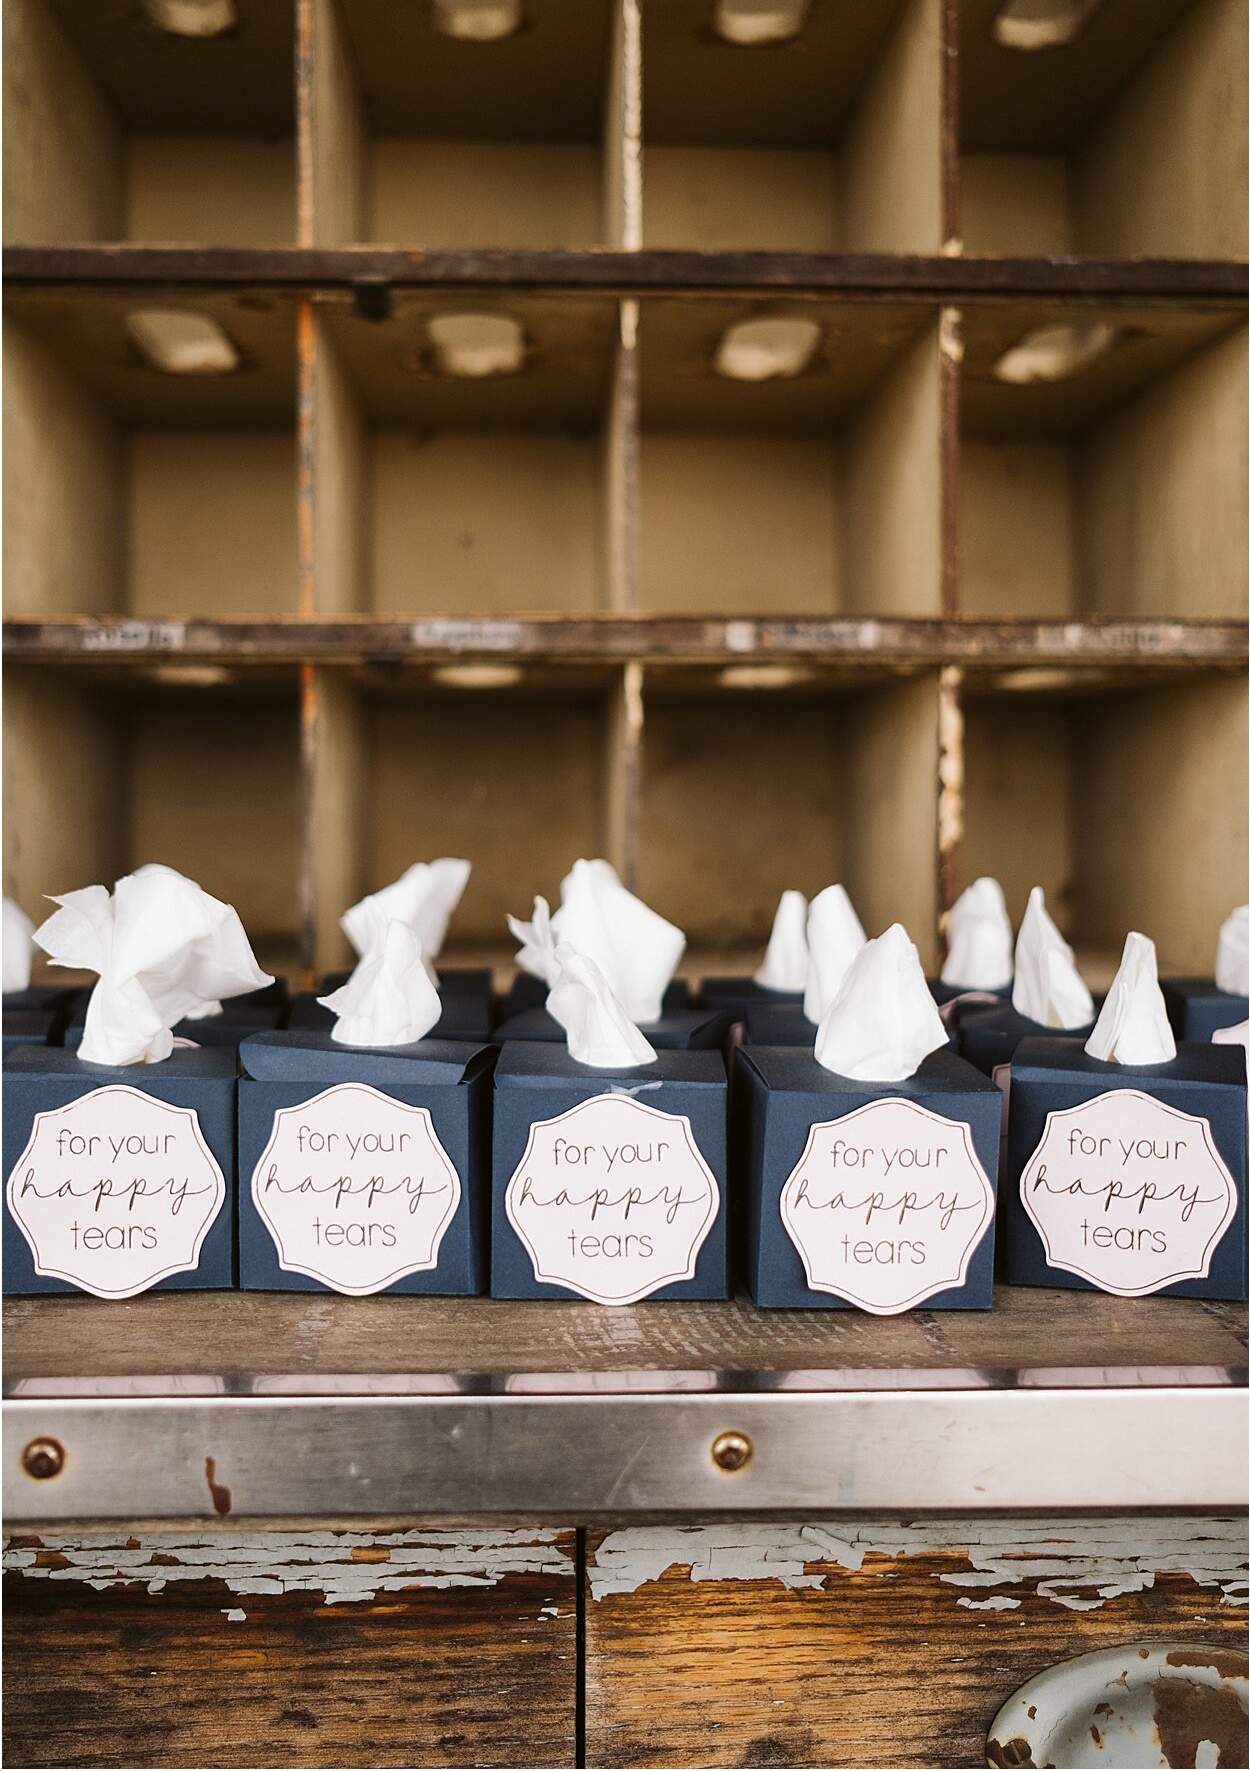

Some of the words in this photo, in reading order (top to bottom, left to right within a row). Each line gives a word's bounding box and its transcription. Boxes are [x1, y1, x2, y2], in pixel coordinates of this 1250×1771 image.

[56, 1129, 102, 1157] for
[108, 1135, 177, 1164] your
[297, 1125, 340, 1153] for
[346, 1133, 412, 1161] your
[552, 1138, 596, 1166] for
[602, 1143, 670, 1174] your
[830, 1140, 875, 1169] for
[881, 1148, 949, 1177] your
[1067, 1128, 1112, 1157] for
[1119, 1139, 1188, 1167] your
[21, 1168, 213, 1216] happy
[265, 1163, 449, 1215] happy
[519, 1177, 707, 1225] happy
[794, 1179, 982, 1231] happy
[1033, 1164, 1225, 1223] happy
[70, 1221, 158, 1251] tears
[312, 1217, 397, 1247] tears
[568, 1229, 654, 1258] tears
[841, 1234, 926, 1265] tears
[1080, 1218, 1167, 1254] tears
